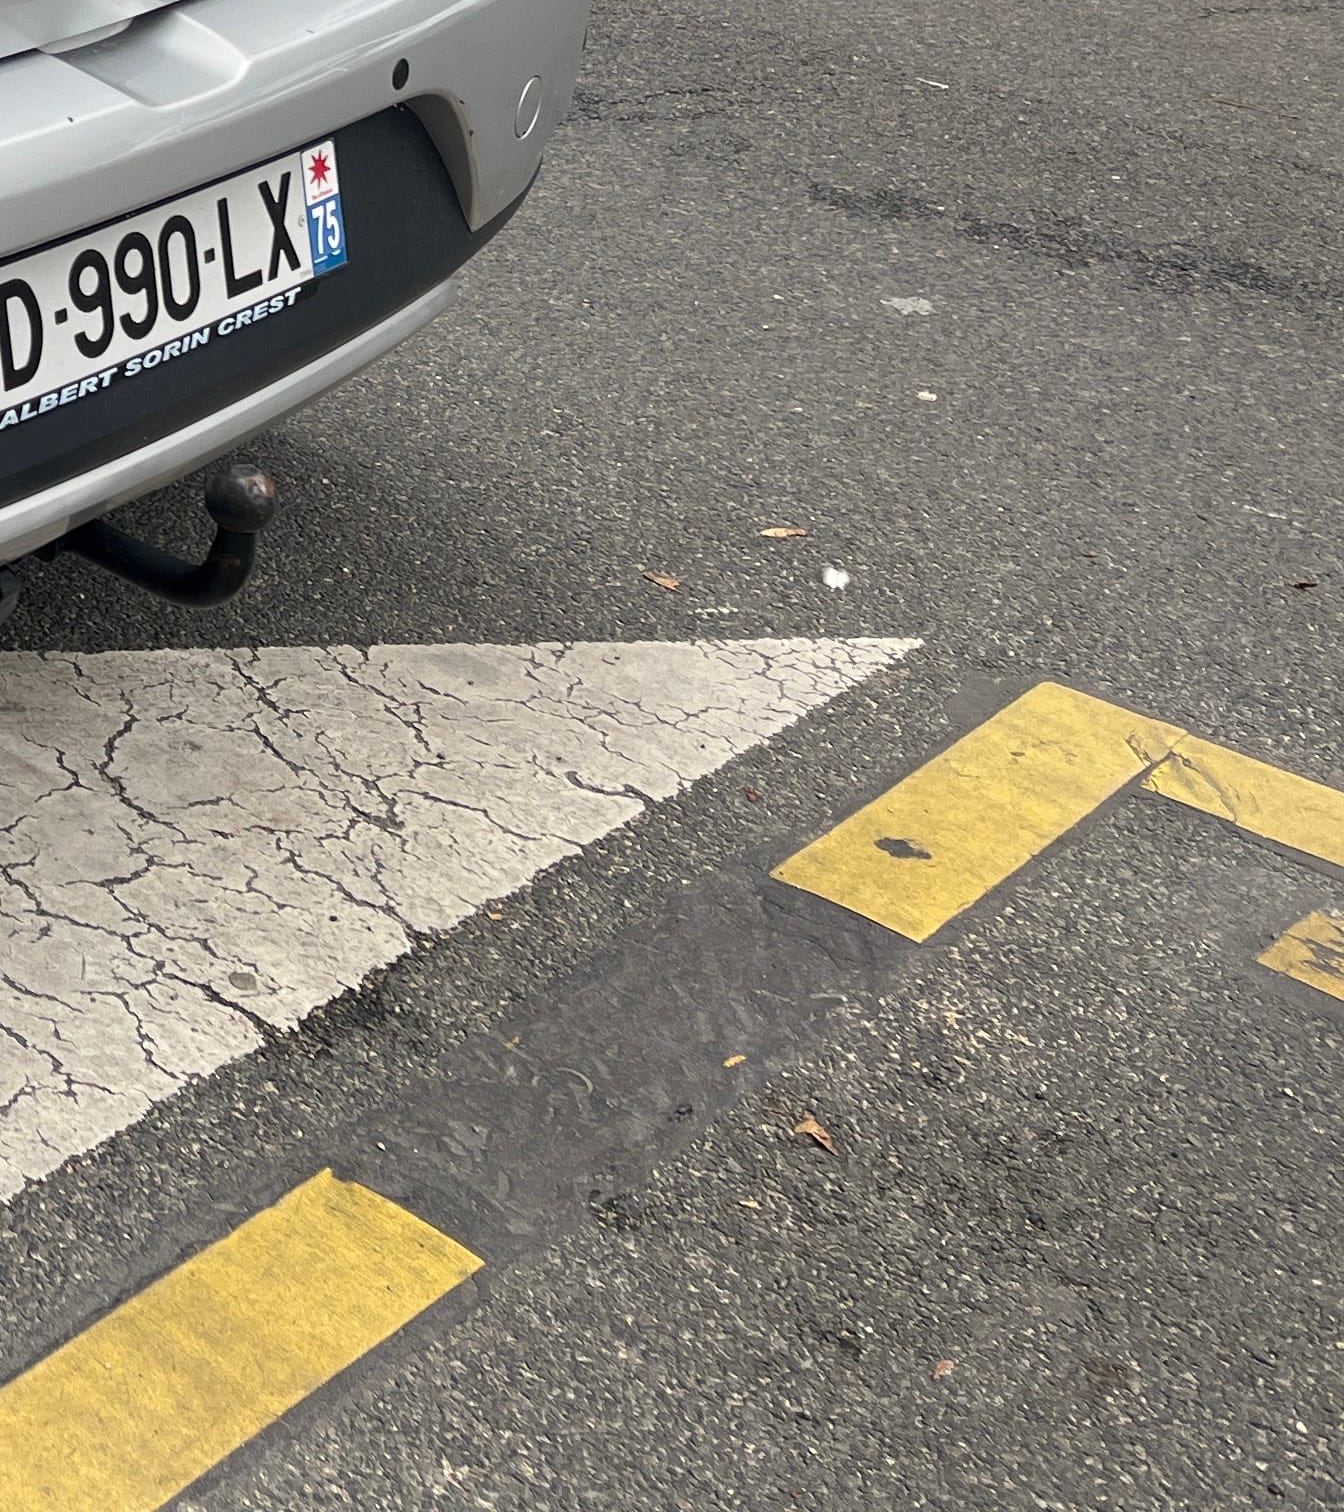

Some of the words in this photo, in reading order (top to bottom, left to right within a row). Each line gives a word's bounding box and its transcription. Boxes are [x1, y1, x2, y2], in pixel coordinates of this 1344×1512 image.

[311, 200, 341, 255] 75
[123, 327, 211, 377] SORIN
[217, 286, 302, 337] CREST
